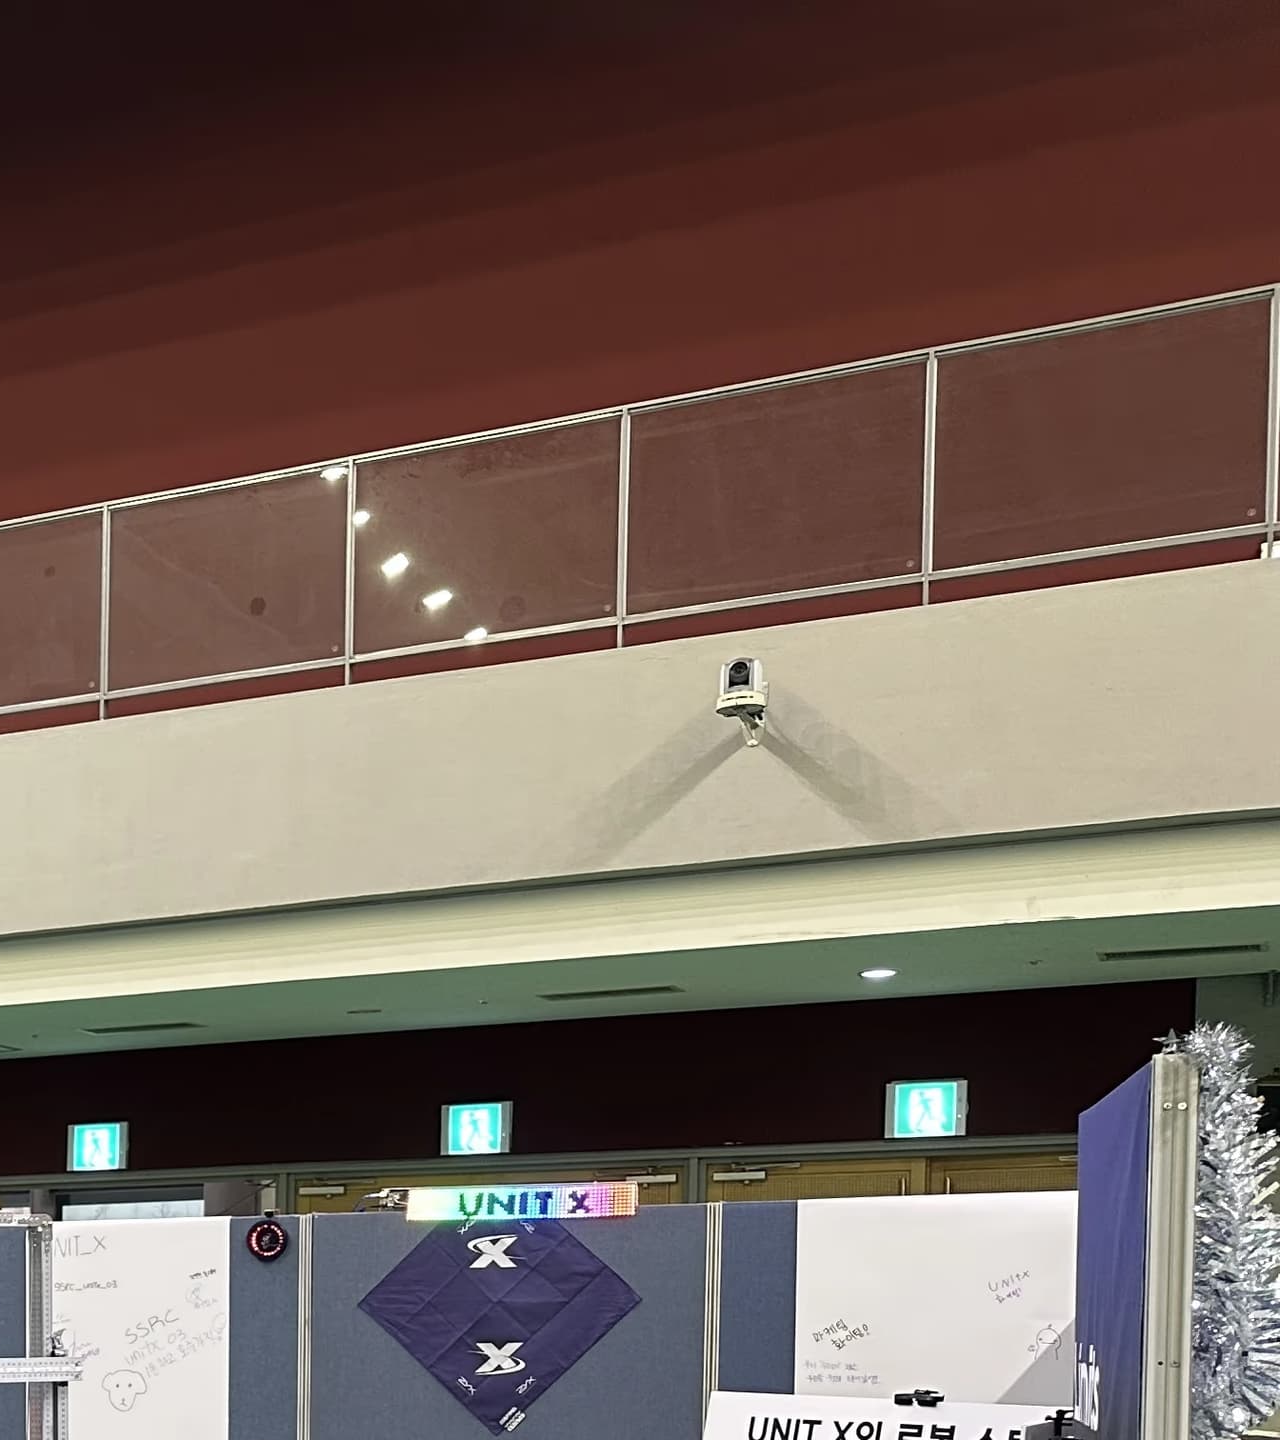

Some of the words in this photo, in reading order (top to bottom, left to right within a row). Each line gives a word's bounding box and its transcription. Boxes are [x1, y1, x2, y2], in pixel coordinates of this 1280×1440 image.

[458, 1191, 553, 1217] UNIT
[568, 1190, 591, 1214] X
[125, 1308, 180, 1344] SSRC
